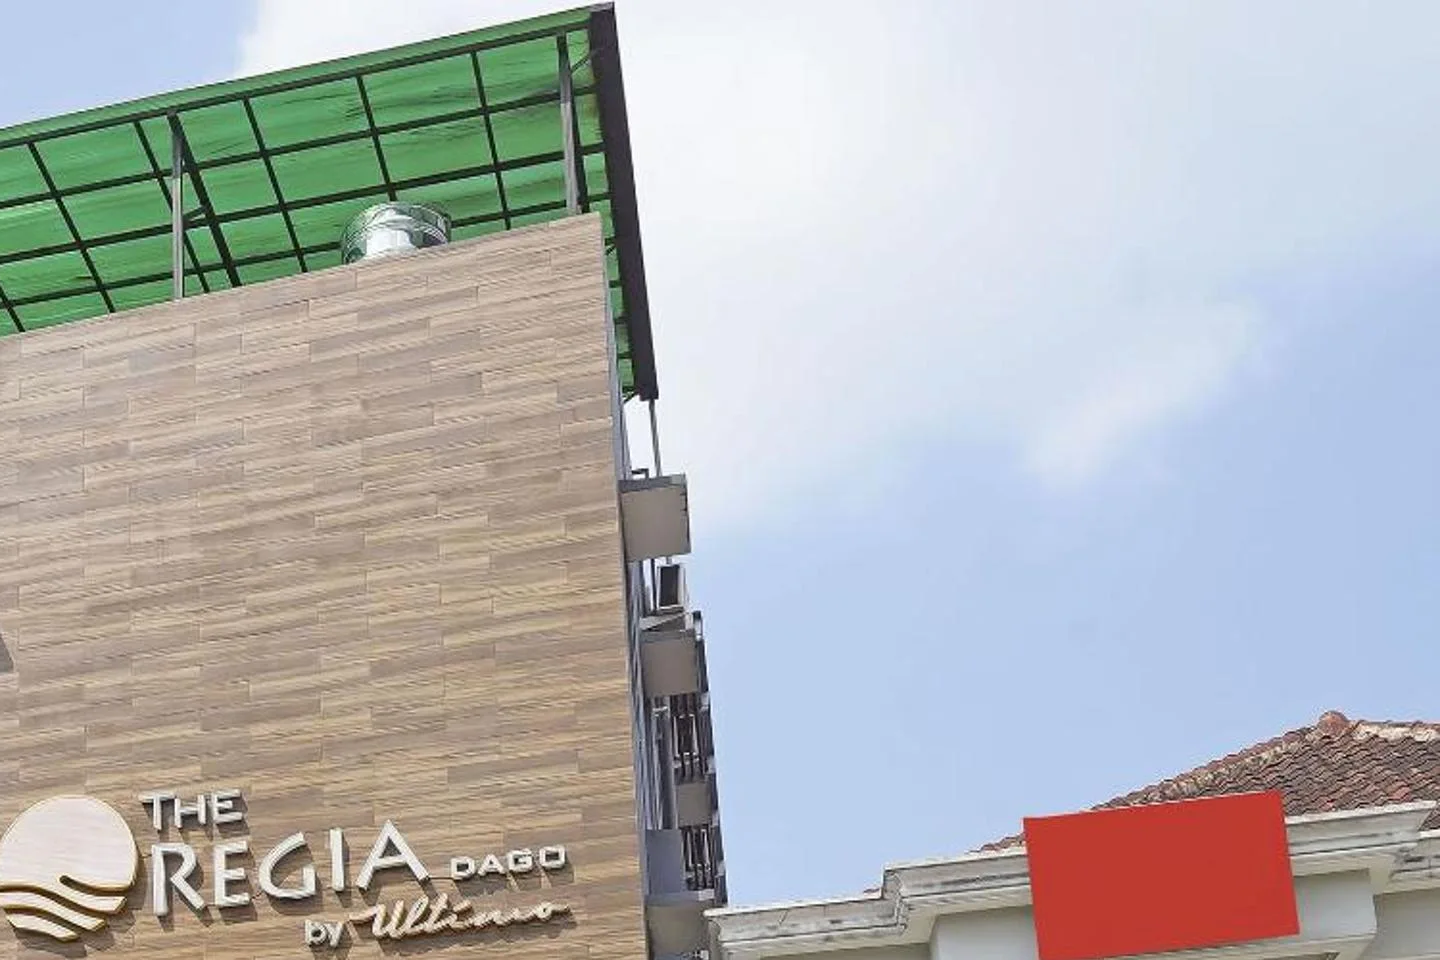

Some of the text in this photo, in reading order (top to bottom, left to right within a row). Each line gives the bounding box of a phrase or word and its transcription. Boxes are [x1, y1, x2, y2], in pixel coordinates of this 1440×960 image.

[137, 787, 244, 830] THE
[151, 818, 567, 916] REGIA DAGO
